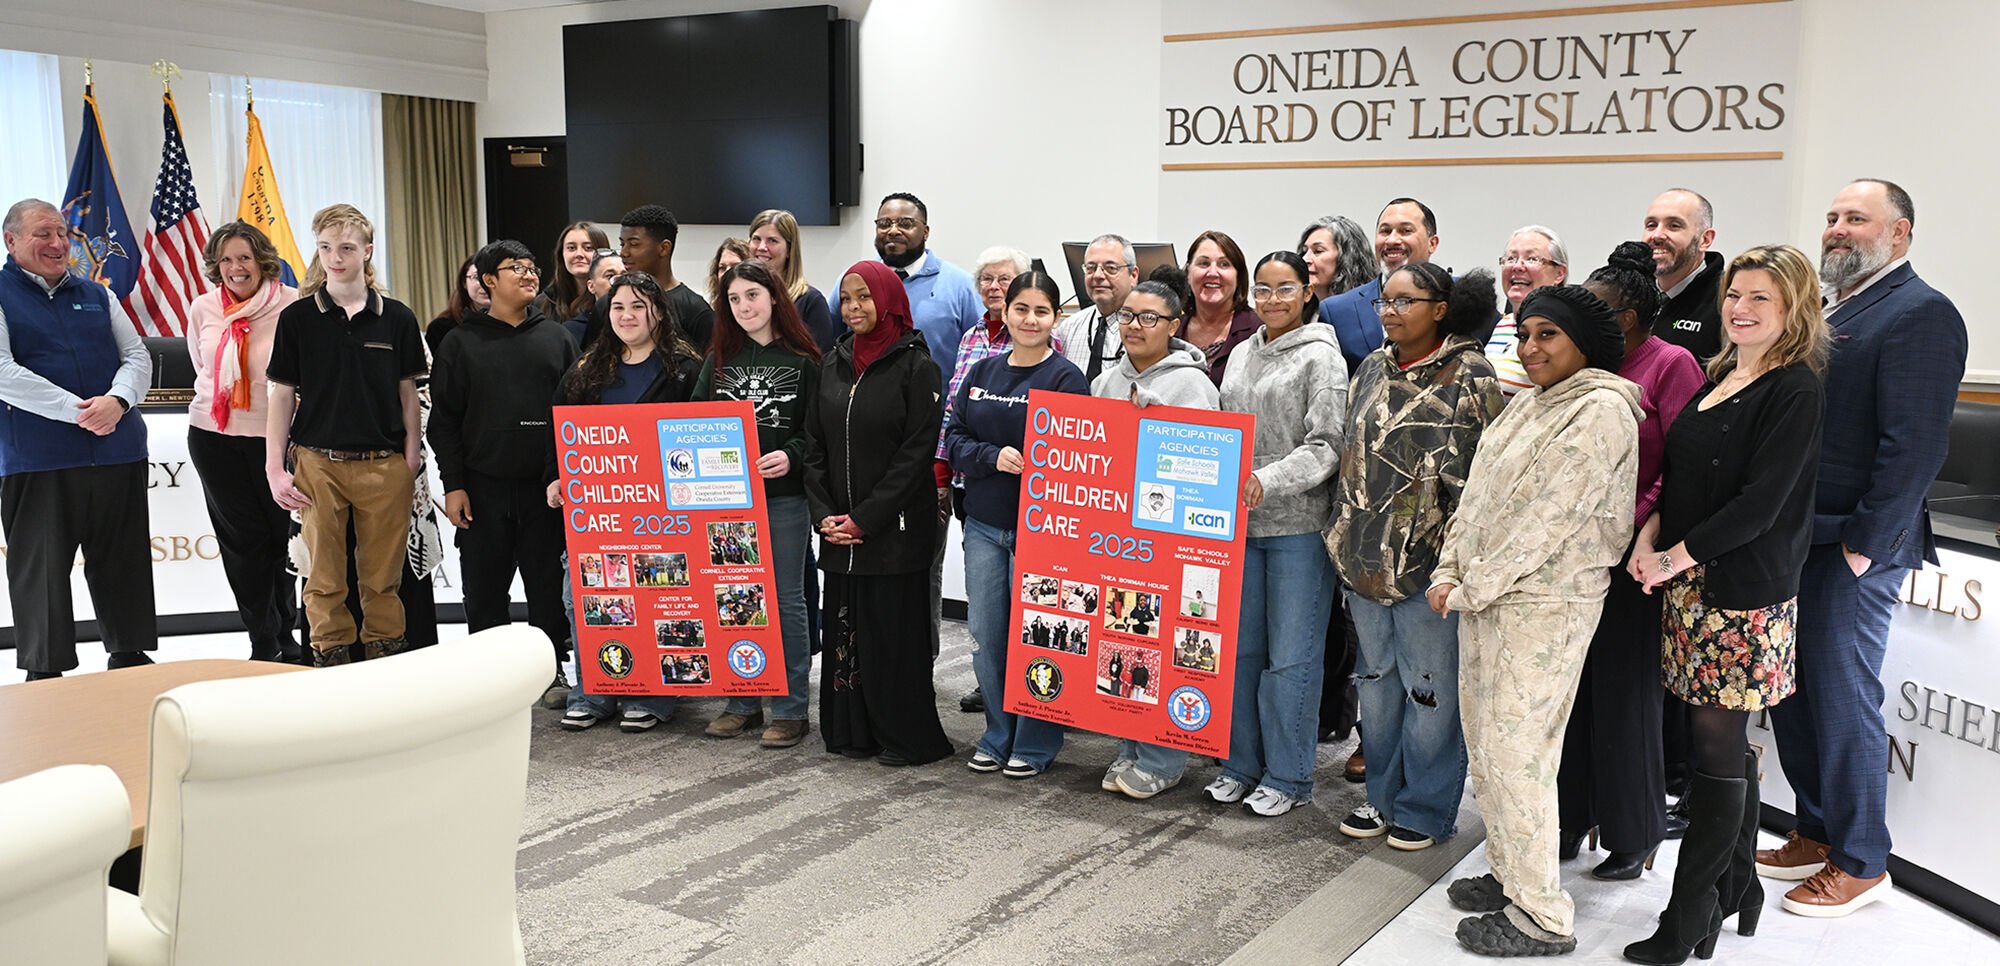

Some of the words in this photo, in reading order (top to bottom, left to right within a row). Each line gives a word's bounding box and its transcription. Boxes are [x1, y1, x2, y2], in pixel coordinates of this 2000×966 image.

[1232, 45, 1419, 95] ONEIDA
[1452, 28, 1697, 85] COUNTY
[1165, 103, 1318, 147] BOARD
[1331, 99, 1396, 142] OF
[1408, 83, 1786, 140] LEGISLATORS
[247, 192, 265, 223] 1798
[561, 421, 630, 445] ONEIDA
[662, 422, 738, 433] PARTICIPATING
[1033, 407, 1107, 443] ONEIDA
[1146, 424, 1235, 444] PARTICIPATING
[676, 434, 728, 444] AGENCIES
[1030, 439, 1113, 477] COUNTY
[1159, 441, 1219, 457] AGENCIES
[564, 450, 638, 474] COUNTY
[1176, 458, 1191, 466] Safe
[1191, 460, 1216, 469] Schools
[567, 479, 660, 504] CHILDREN
[1027, 471, 1128, 513] CHILDREN
[1175, 494, 1205, 503] BOWMAN
[1182, 487, 1199, 495] THEA
[570, 508, 622, 532] CARE
[632, 514, 691, 535] 2025
[1025, 504, 1081, 539] CARE
[1088, 531, 1154, 563] 2025
[1174, 553, 1203, 562] MOHAWK
[1205, 557, 1231, 566] VALLEY
[1177, 545, 1195, 553] SAFE
[1197, 548, 1229, 559] SCHOOLS
[1052, 565, 1068, 573] ICAN
[1100, 574, 1117, 582] THEA
[1118, 577, 1146, 587] BOWMAN
[1147, 581, 1170, 591] HOUSE
[1154, 735, 1172, 744] Youth
[1166, 730, 1182, 738] Kevin
